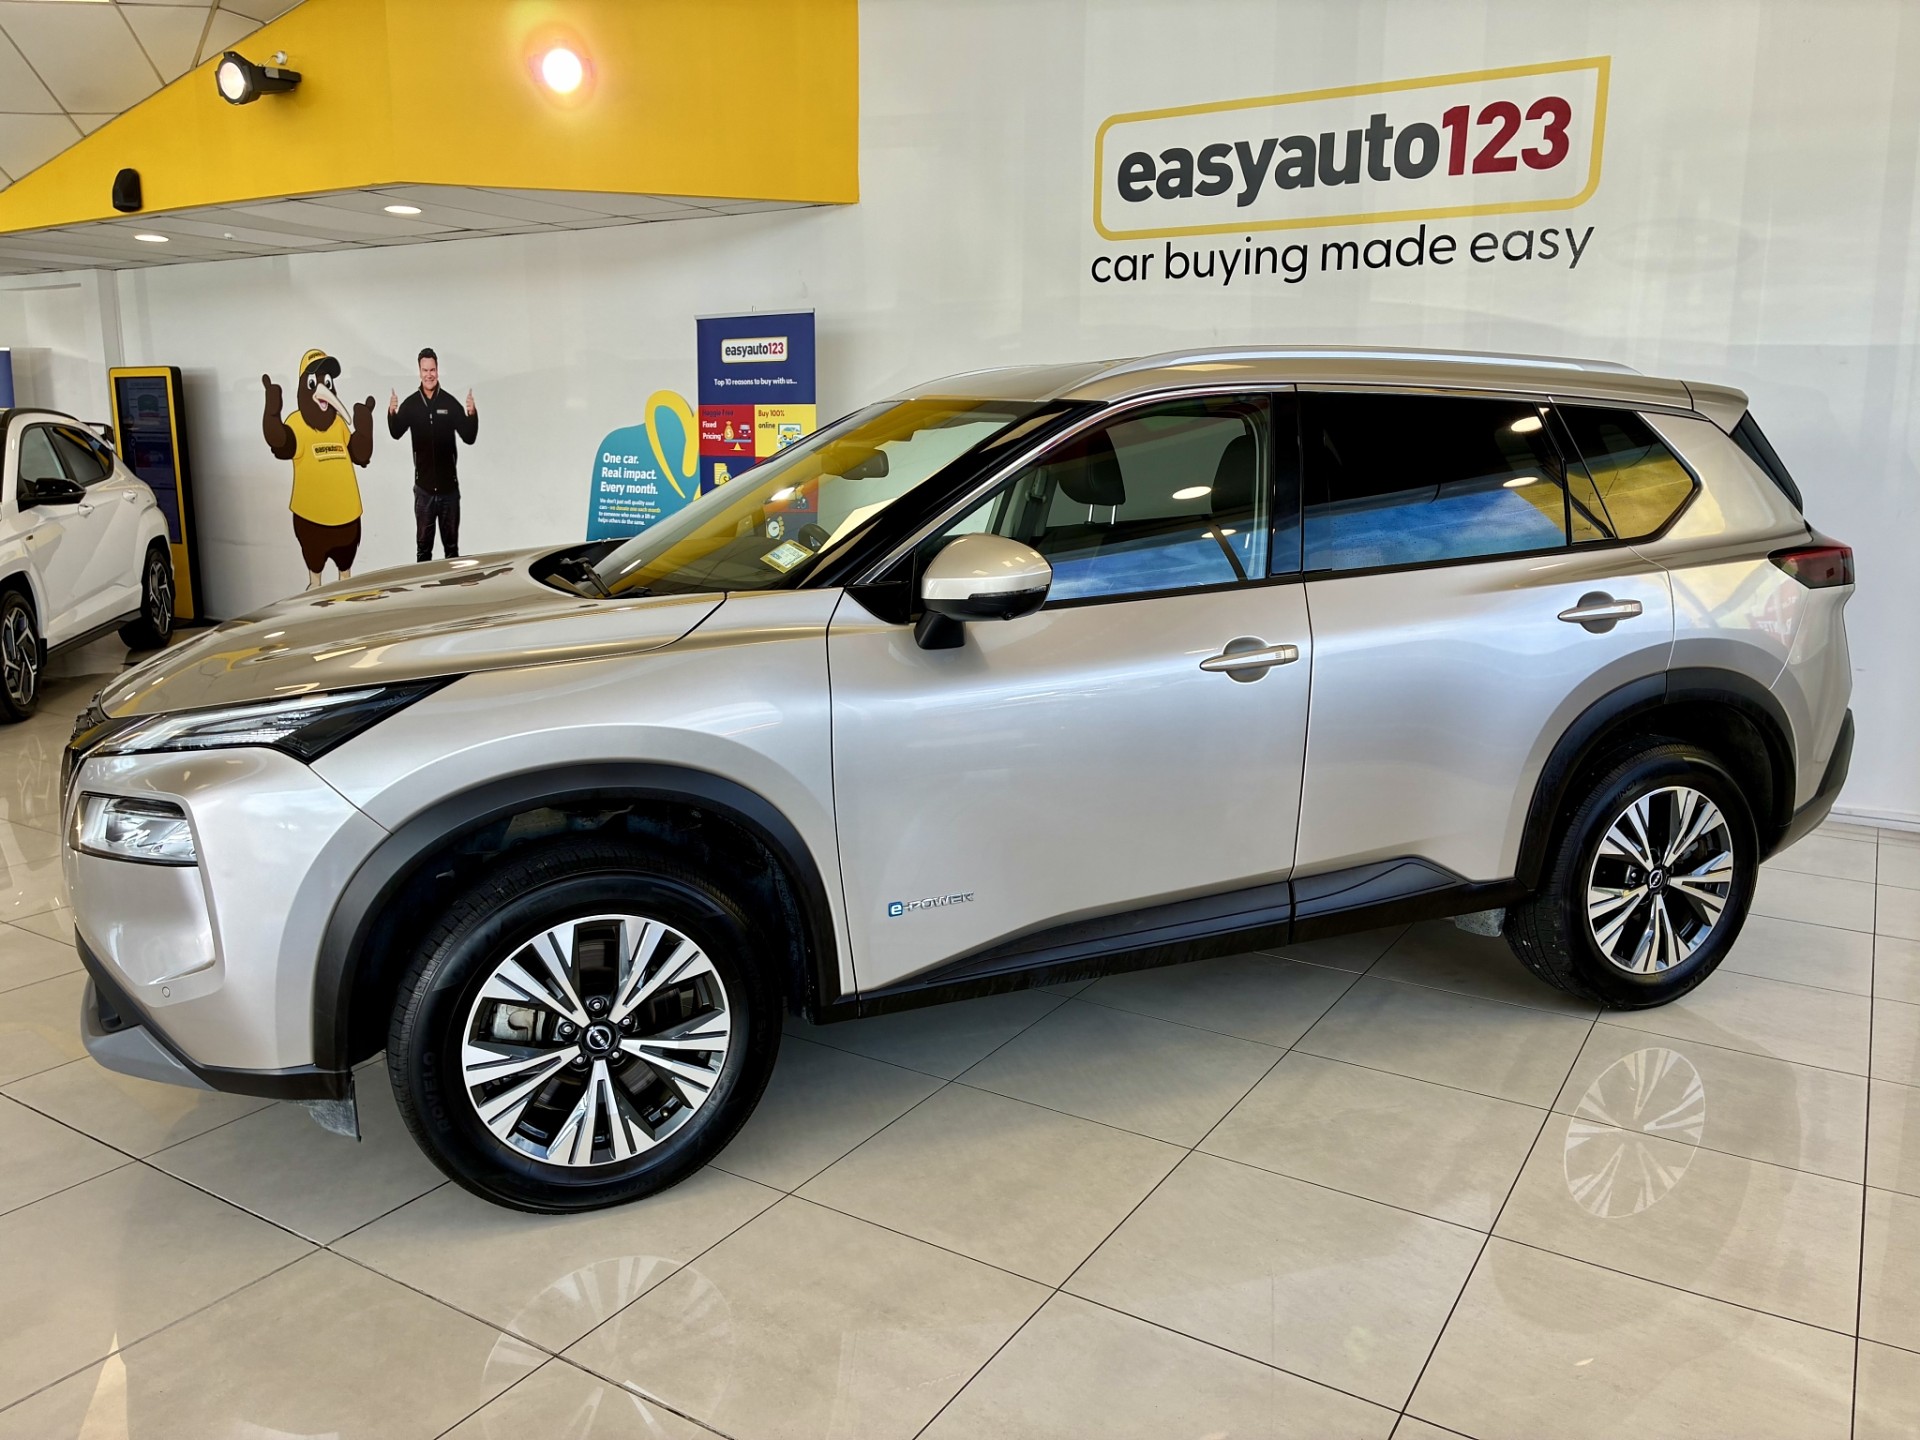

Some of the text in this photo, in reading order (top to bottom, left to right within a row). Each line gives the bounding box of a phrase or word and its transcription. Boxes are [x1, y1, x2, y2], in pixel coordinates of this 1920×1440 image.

[1116, 96, 1572, 208] easyauto123
[1091, 223, 1595, 287] car buying made easy
[725, 341, 784, 358] easyauto123
[713, 378, 725, 388] Top
[725, 378, 731, 386] 10
[760, 377, 771, 387] buy
[772, 376, 786, 385] with
[758, 409, 785, 418] Buy 100%
[702, 420, 717, 428] Fixed
[603, 452, 639, 464] One car.
[601, 467, 657, 481] Real impact.
[600, 481, 658, 495] Every month.
